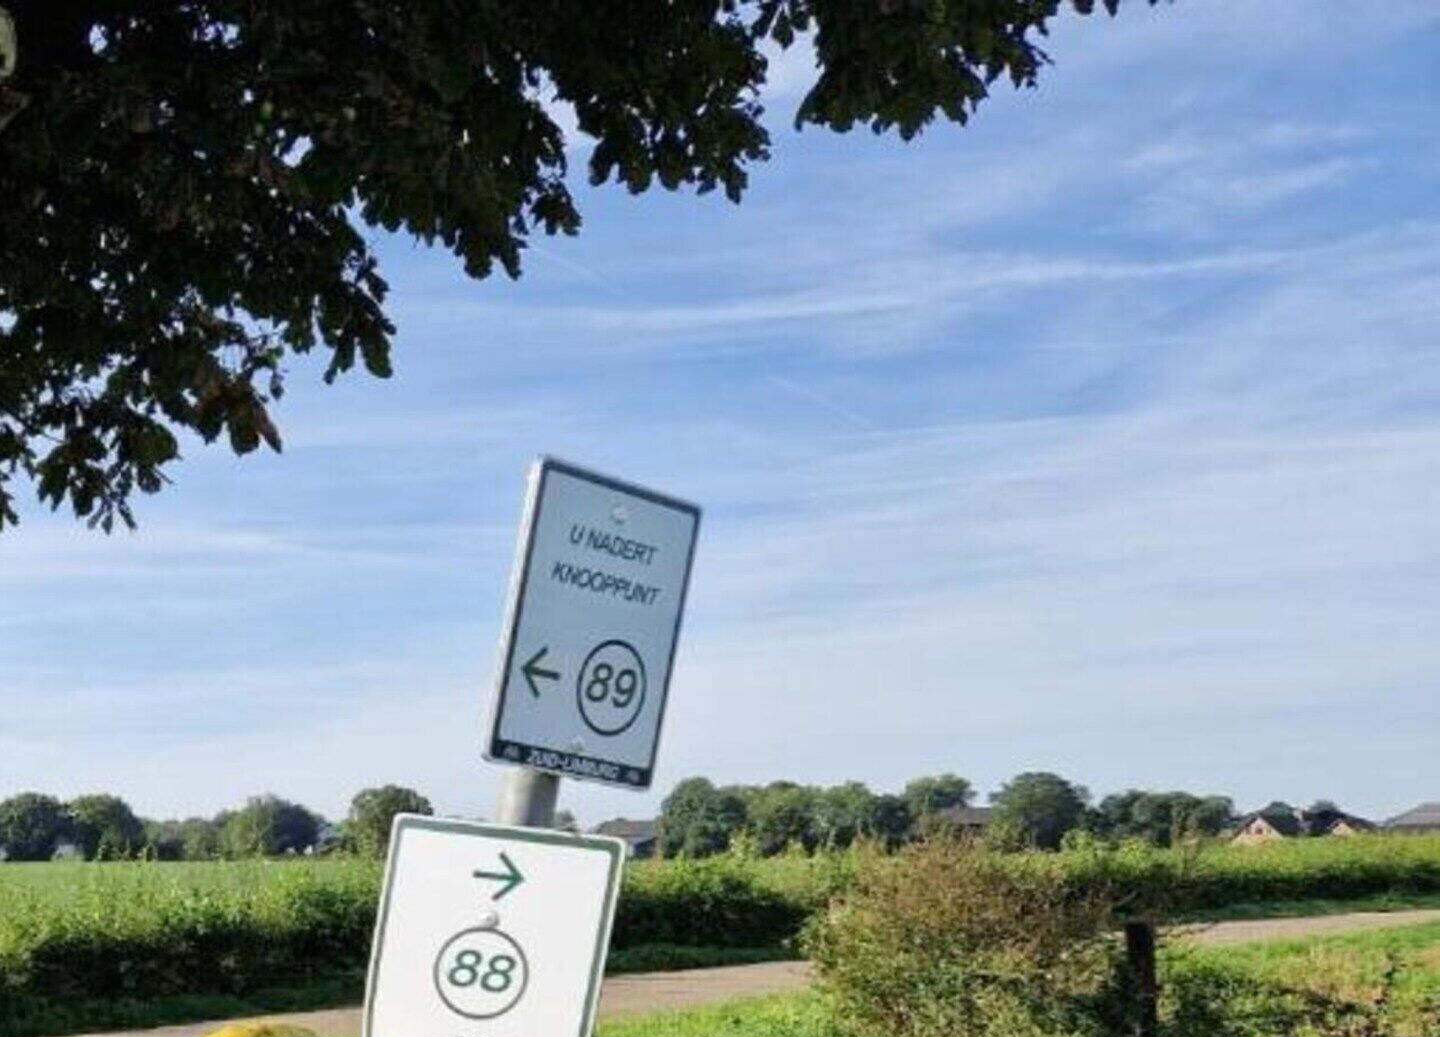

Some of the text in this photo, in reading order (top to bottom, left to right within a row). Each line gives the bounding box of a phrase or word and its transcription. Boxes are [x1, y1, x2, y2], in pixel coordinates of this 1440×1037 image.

[570, 524, 658, 565] U NADERT
[551, 562, 661, 605] KNOOPPUNT
[585, 663, 638, 708] 89
[448, 950, 517, 992] 88
